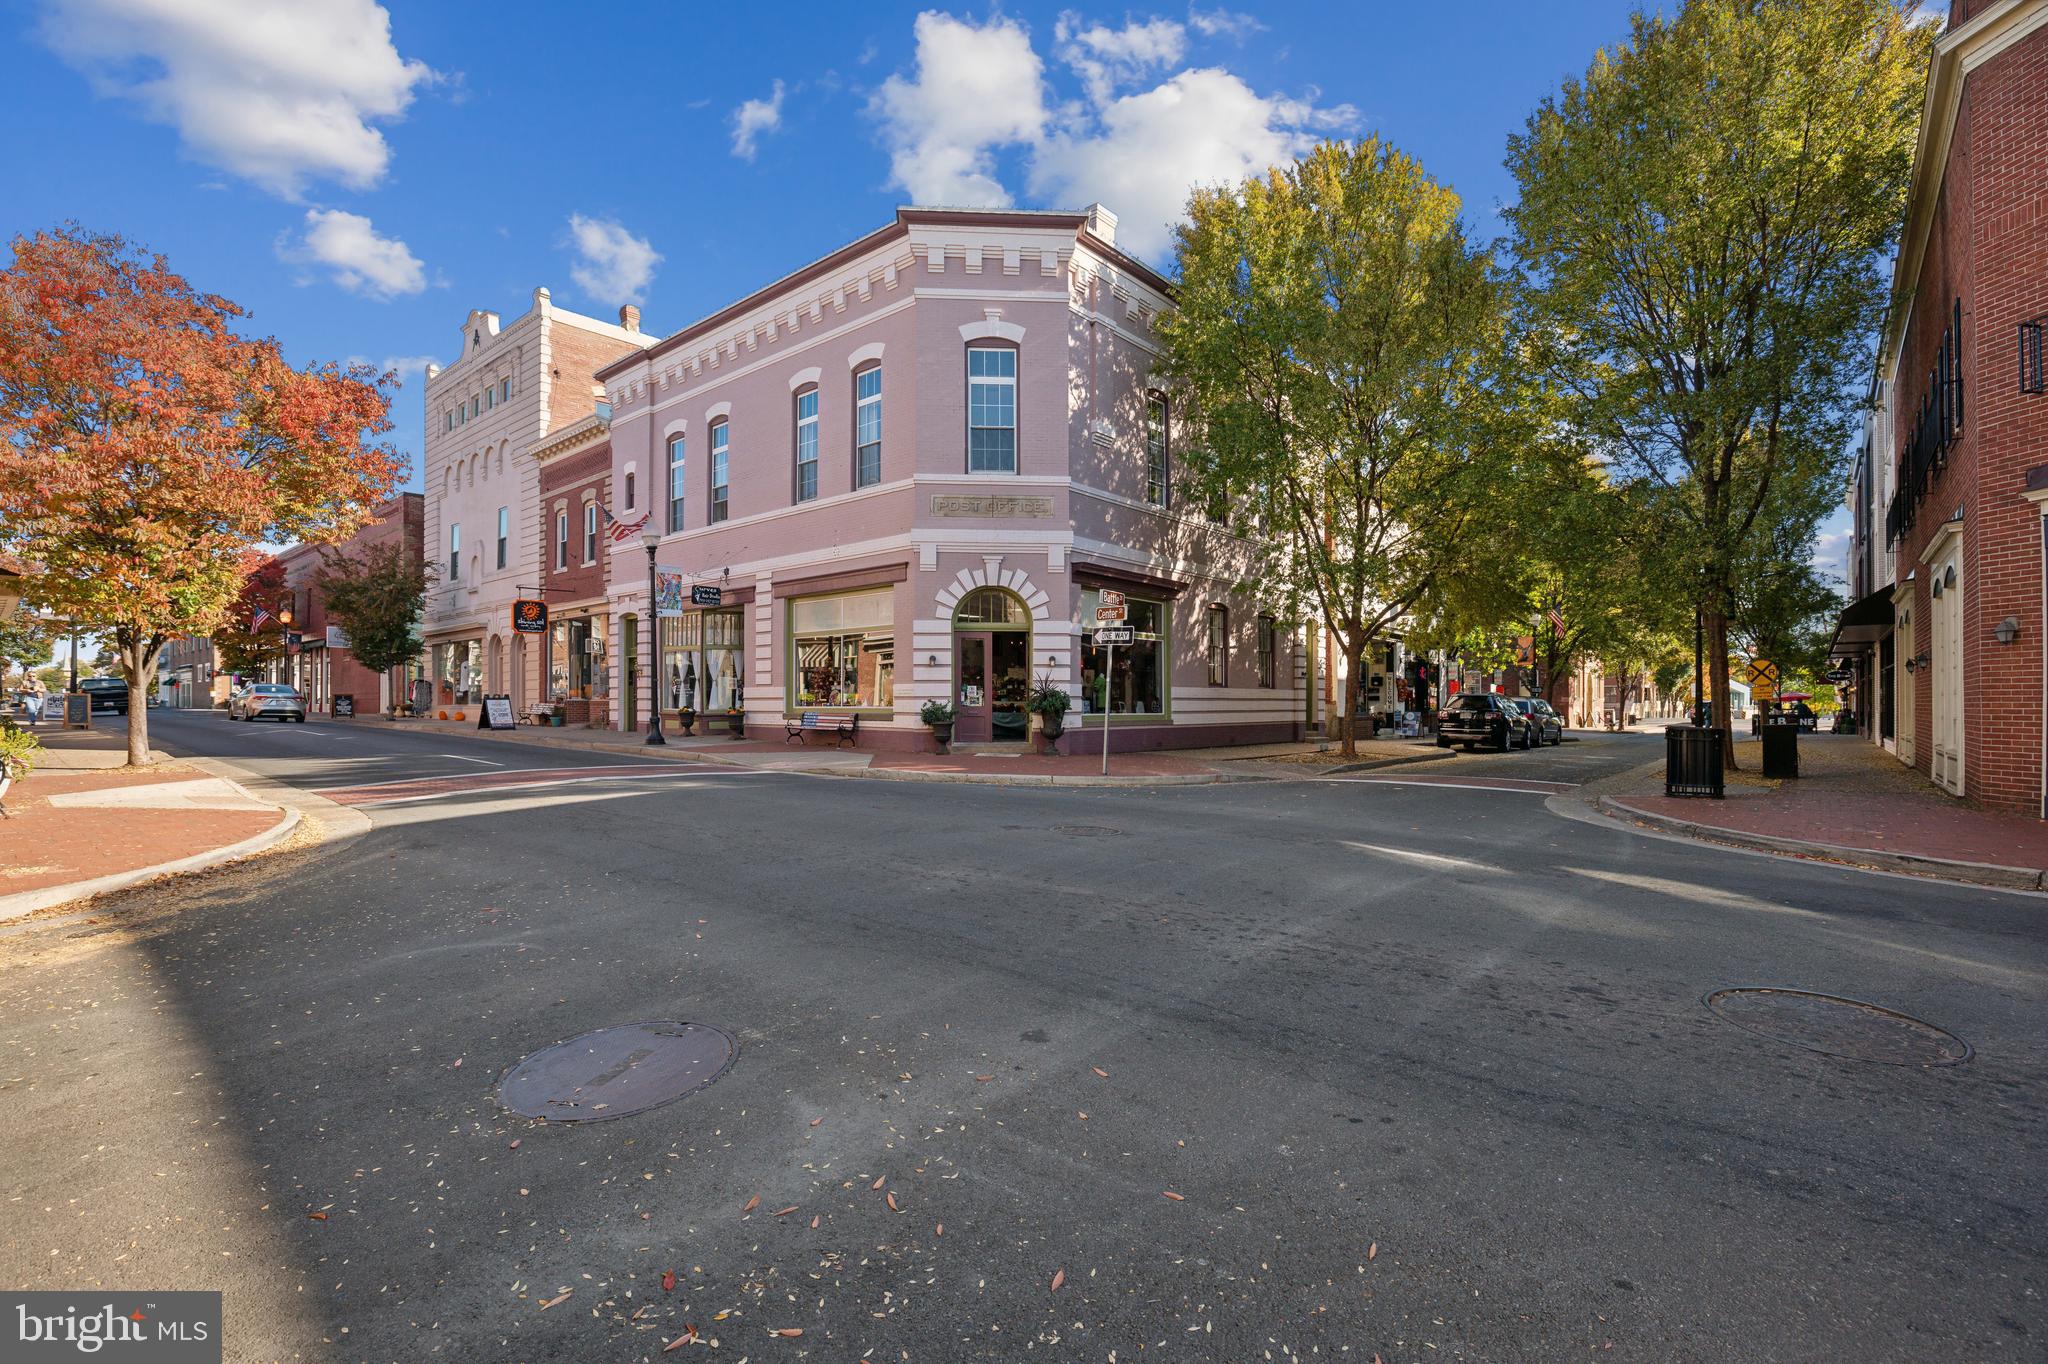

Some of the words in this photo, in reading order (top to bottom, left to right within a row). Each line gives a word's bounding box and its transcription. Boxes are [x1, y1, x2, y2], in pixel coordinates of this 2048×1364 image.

[938, 500, 981, 513] POST
[1103, 591, 1120, 605] Battle
[1097, 609, 1118, 620] Center
[1101, 632, 1113, 640] ONE
[1114, 632, 1129, 640] WAY
[1747, 669, 1755, 677] R
[1768, 668, 1775, 676] R
